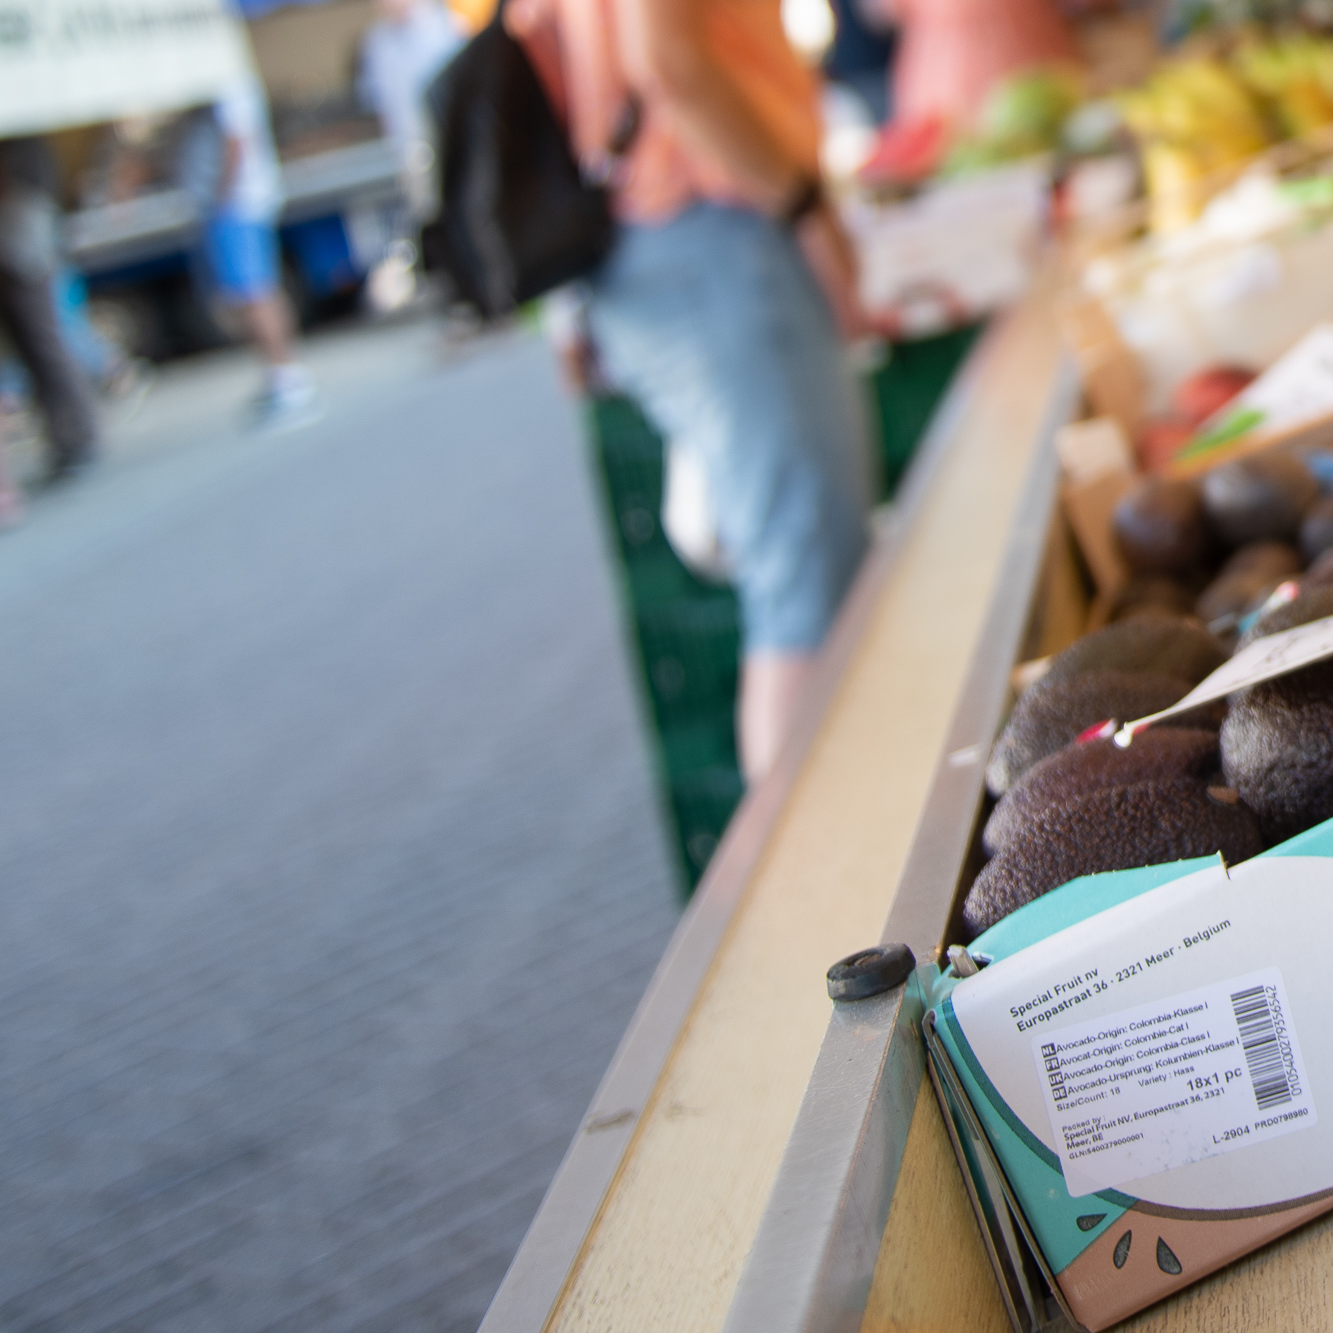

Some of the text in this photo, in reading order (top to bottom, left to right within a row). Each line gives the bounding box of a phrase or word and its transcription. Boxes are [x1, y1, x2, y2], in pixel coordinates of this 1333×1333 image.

[1009, 968, 1099, 1018] Special Fruit nv
[1016, 919, 1231, 1032] Europastraat 36 2321 Meer Belgium
[1042, 1044, 1055, 1057] NL
[1056, 1026, 1128, 1053] Avocado-Origin:
[1129, 1003, 1204, 1032] Colombia-Klasse
[1046, 1058, 1060, 1071] FR
[1060, 1042, 1123, 1068] Avocat-Origin:
[1124, 1024, 1184, 1048] Colombie-Cat
[1049, 1072, 1063, 1086] UK
[1064, 1054, 1135, 1081] Avocado-Origin:
[1136, 1032, 1206, 1060] Colombia-Class
[1053, 1087, 1067, 1100] DE
[1067, 1064, 1154, 1096] Avocado-Ursprung:
[1155, 1038, 1235, 1068] Kolumbien-Klasse
[1186, 1067, 1243, 1091] 18x1 pc
[1056, 1092, 1108, 1112] Size/Count:
[1110, 1086, 1121, 1097] 18
[1173, 1065, 1195, 1077] Hass
[1062, 1119, 1091, 1133] Packed
[1064, 1087, 1225, 1142] Special Fruit NV, Europastraat 36, 2321
[1213, 1125, 1250, 1145] L-2904
[1066, 1133, 1104, 1151] Meer, BE
